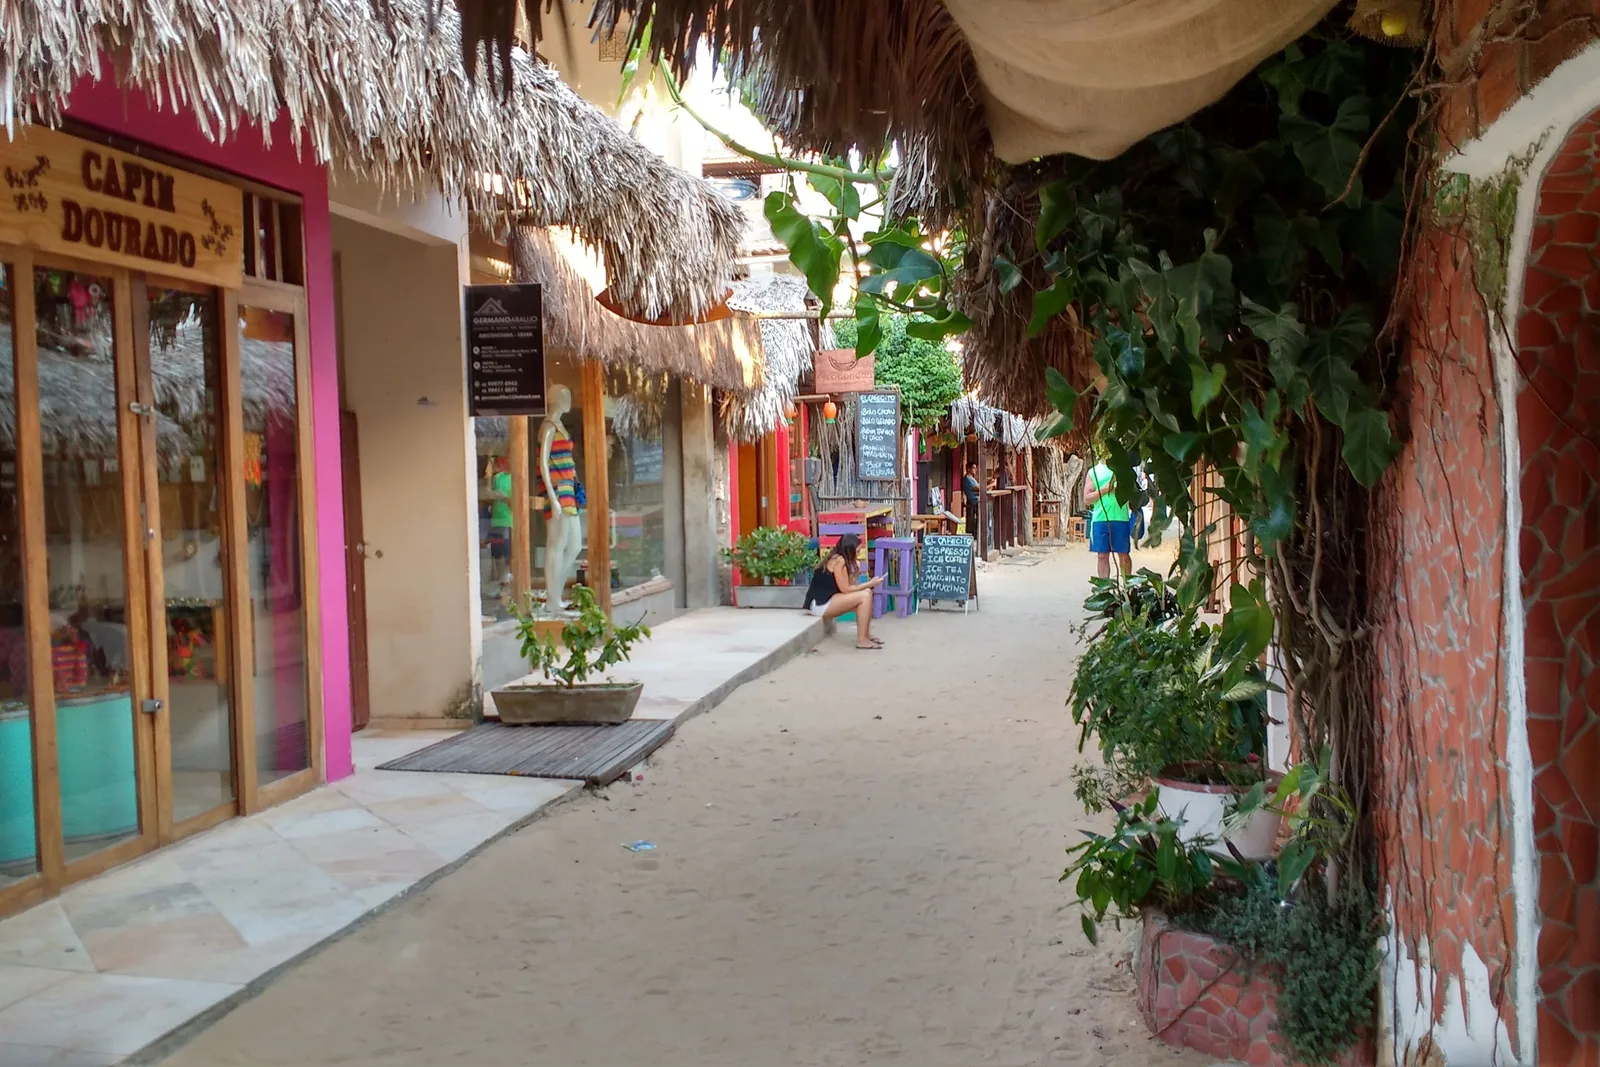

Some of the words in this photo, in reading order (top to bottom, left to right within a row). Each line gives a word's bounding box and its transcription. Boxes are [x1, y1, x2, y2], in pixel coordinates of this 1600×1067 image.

[81, 150, 176, 213] CAPIM
[61, 200, 196, 268] DOURADO
[924, 537, 936, 546] EL
[928, 547, 970, 556] ESPRESSO
[927, 555, 943, 563] ICE
[926, 565, 942, 573] ICE
[945, 565, 962, 574] TEA
